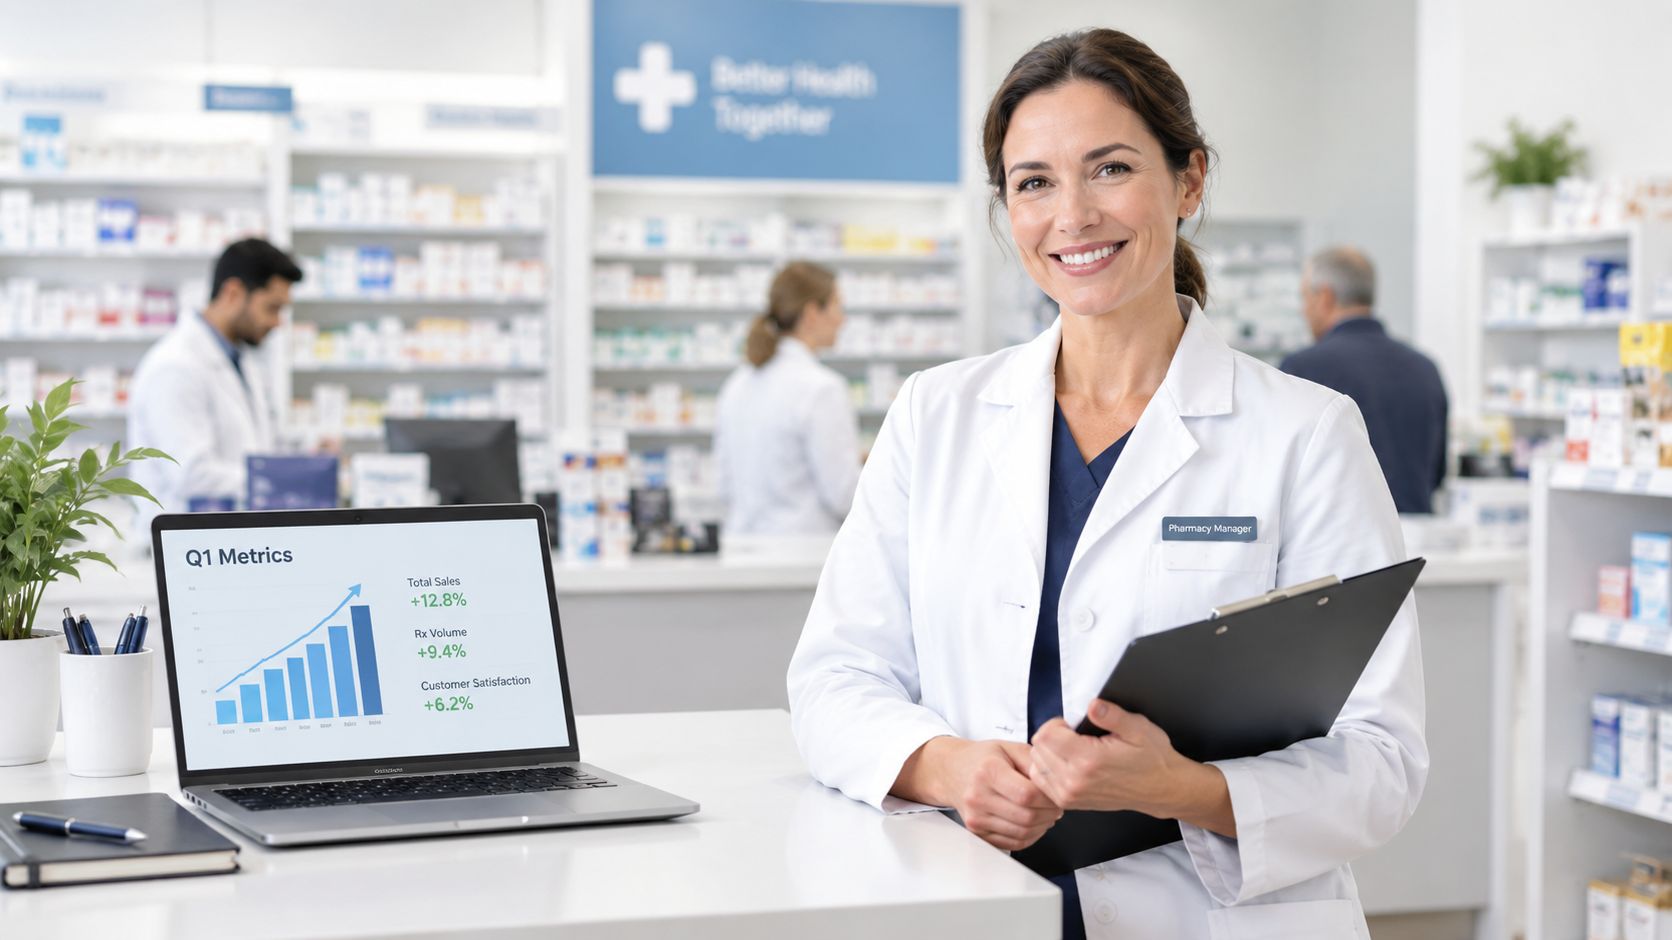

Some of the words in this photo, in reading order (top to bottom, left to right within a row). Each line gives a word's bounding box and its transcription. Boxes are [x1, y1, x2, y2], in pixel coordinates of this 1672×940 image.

[711, 56, 788, 93] Better
[793, 61, 876, 98] Health
[712, 96, 833, 141] Together
[1168, 523, 1212, 534] Pharmacy
[1214, 525, 1252, 534] Manager
[185, 549, 212, 567] Q1
[219, 546, 293, 565] Metrics
[407, 577, 432, 588] Total
[434, 576, 461, 587] Sales
[411, 592, 467, 608] +12.8%
[414, 629, 427, 639] Rx
[429, 627, 467, 638] Volume
[417, 644, 467, 660] +9.4%
[421, 680, 470, 691] Customer
[472, 675, 531, 689] Satisfaction
[424, 696, 474, 712] +6.2%
